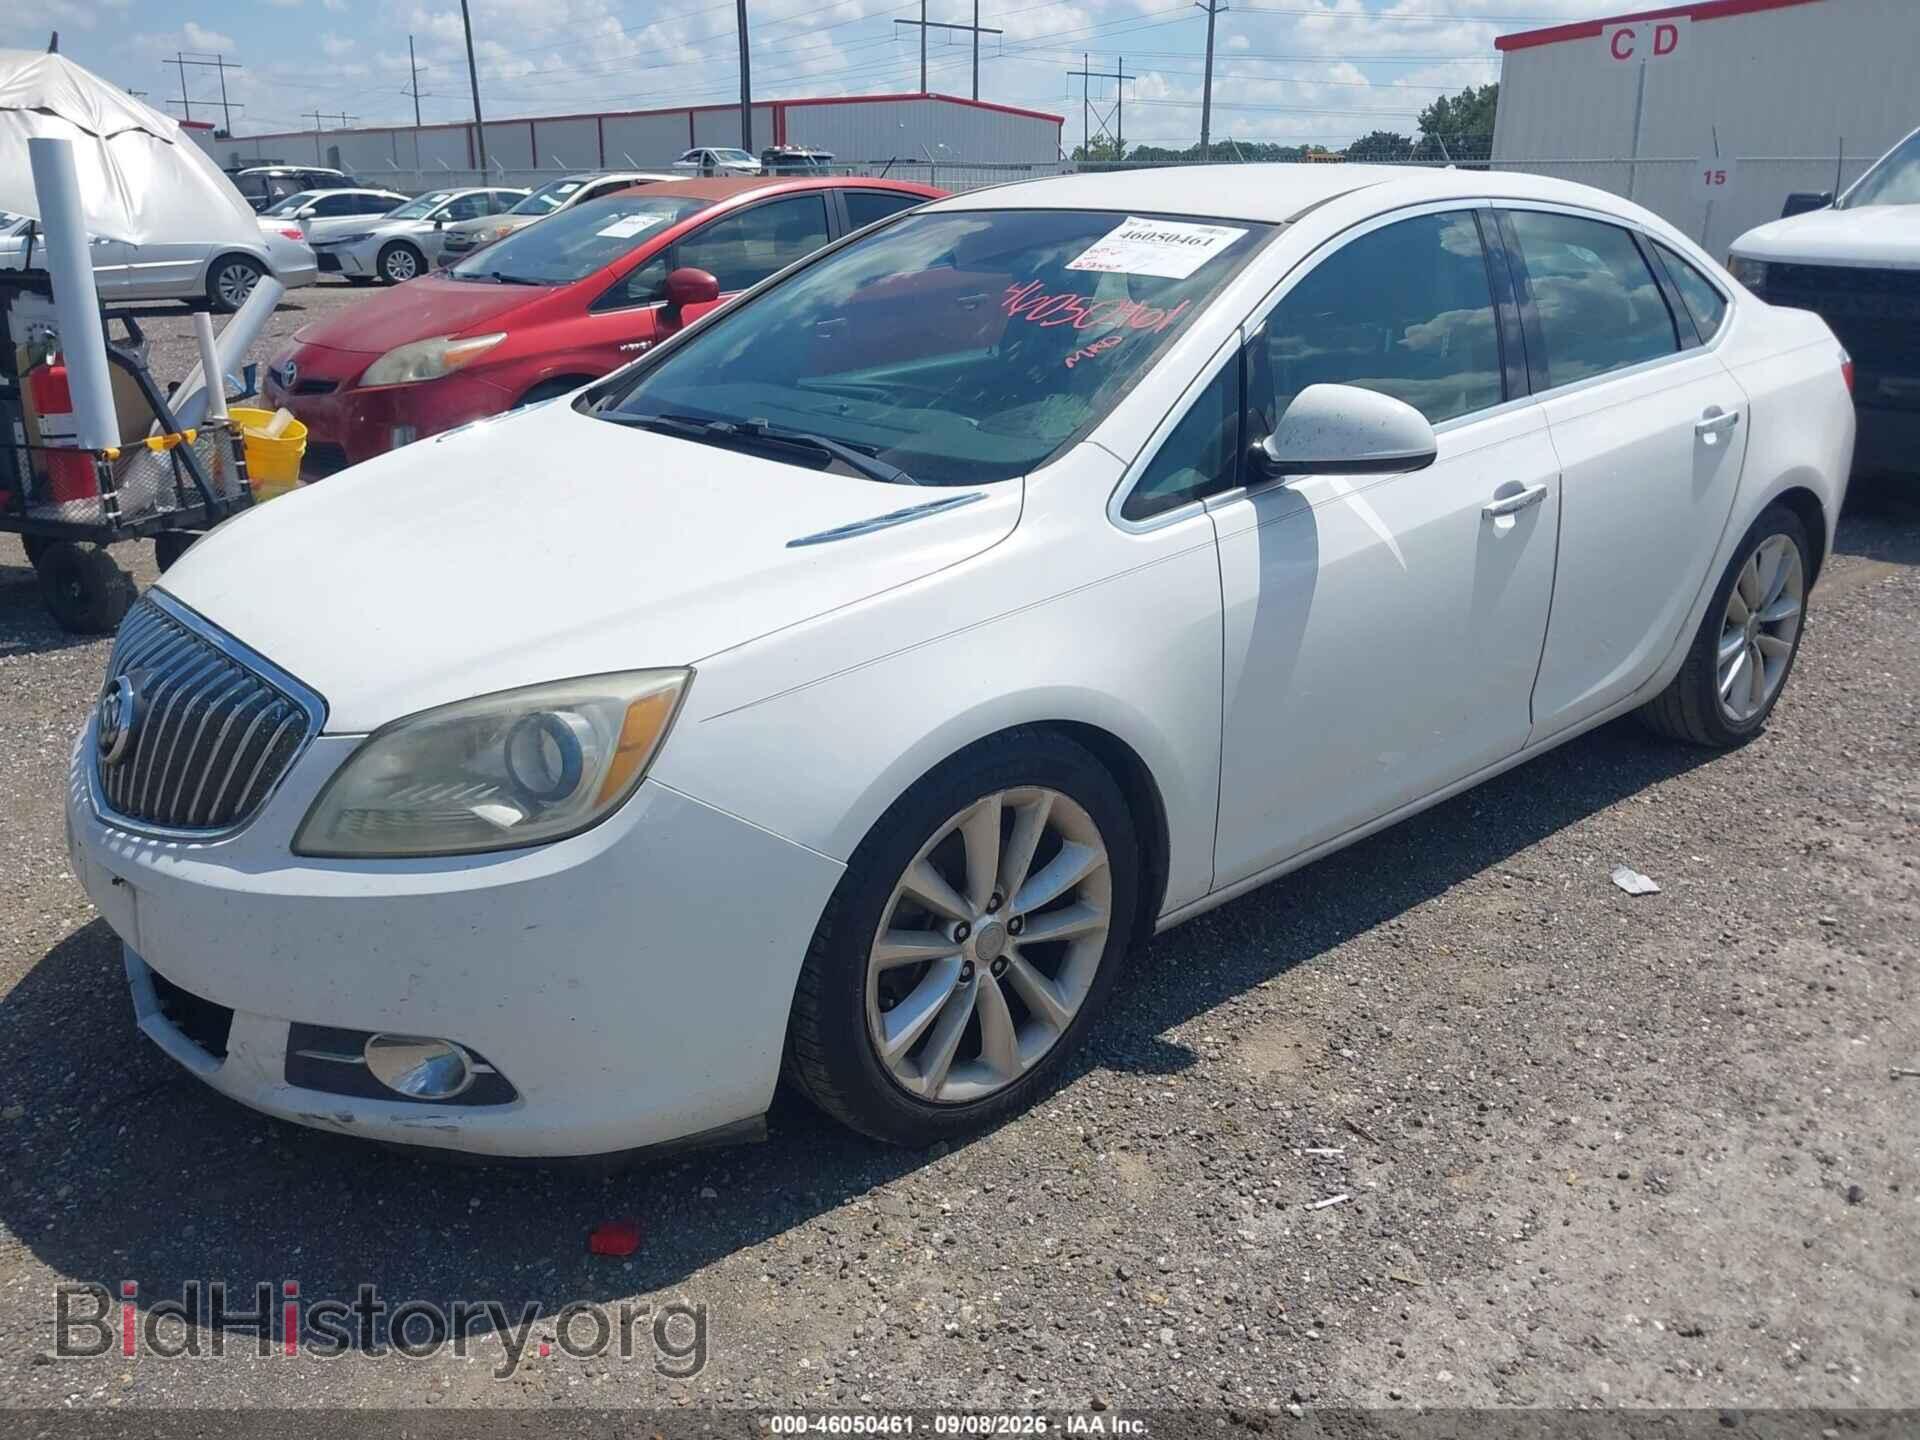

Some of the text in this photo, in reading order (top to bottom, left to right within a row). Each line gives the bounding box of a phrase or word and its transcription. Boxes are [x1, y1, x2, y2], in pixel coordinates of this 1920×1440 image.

[1610, 23, 1679, 61] C D
[1703, 169, 1727, 186] 15
[1119, 229, 1215, 247] 46050461
